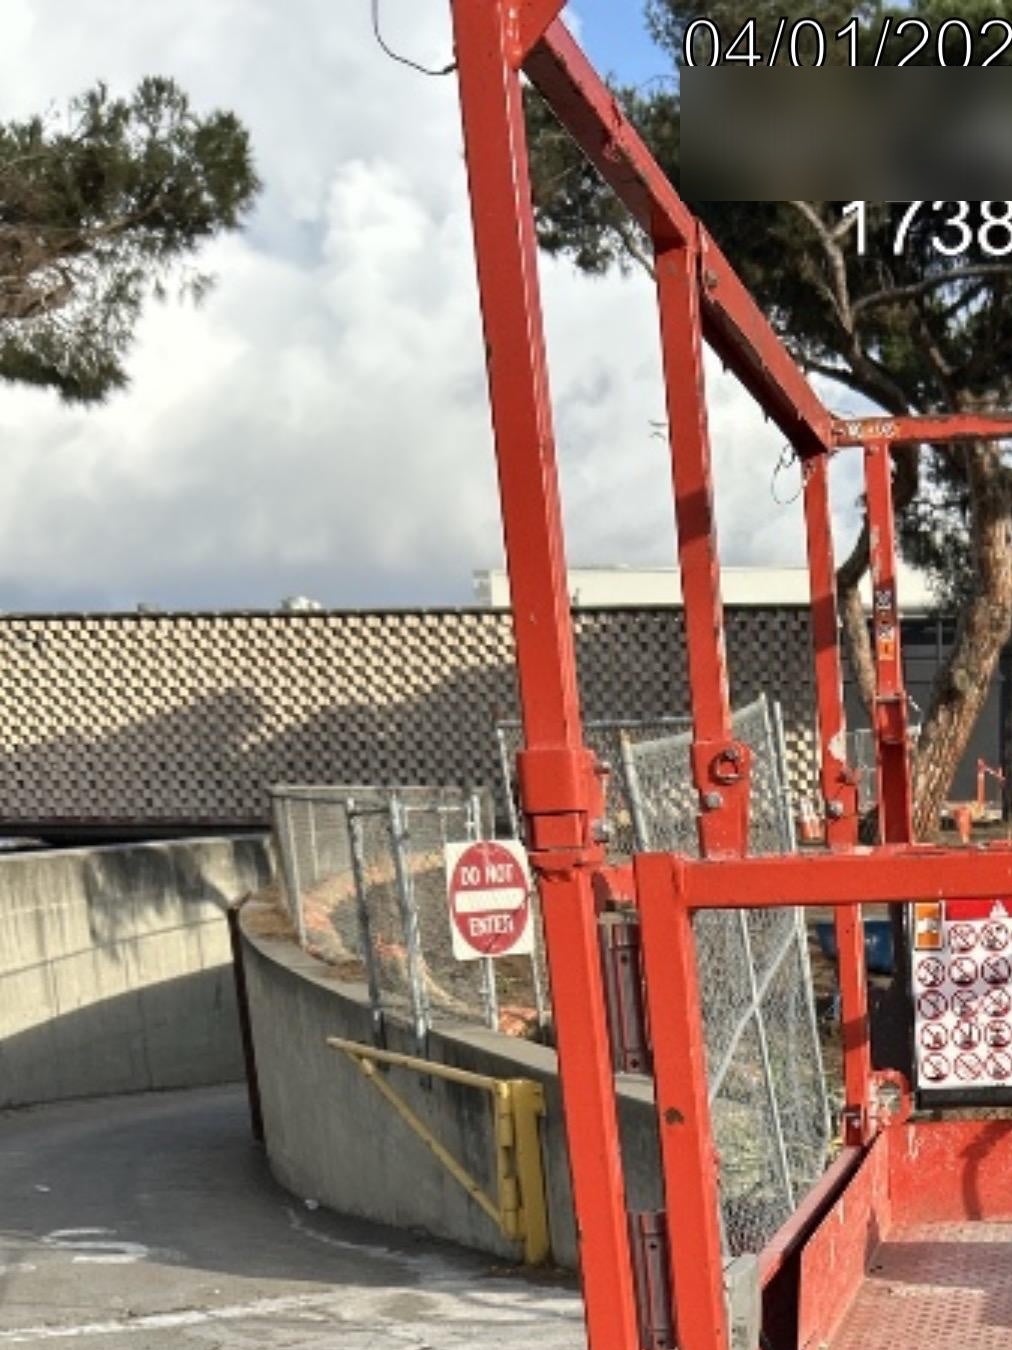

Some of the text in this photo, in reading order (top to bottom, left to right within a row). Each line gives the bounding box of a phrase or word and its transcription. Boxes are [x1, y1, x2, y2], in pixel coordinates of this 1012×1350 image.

[460, 863, 513, 886] DO NOT
[469, 915, 514, 937] ENTER
